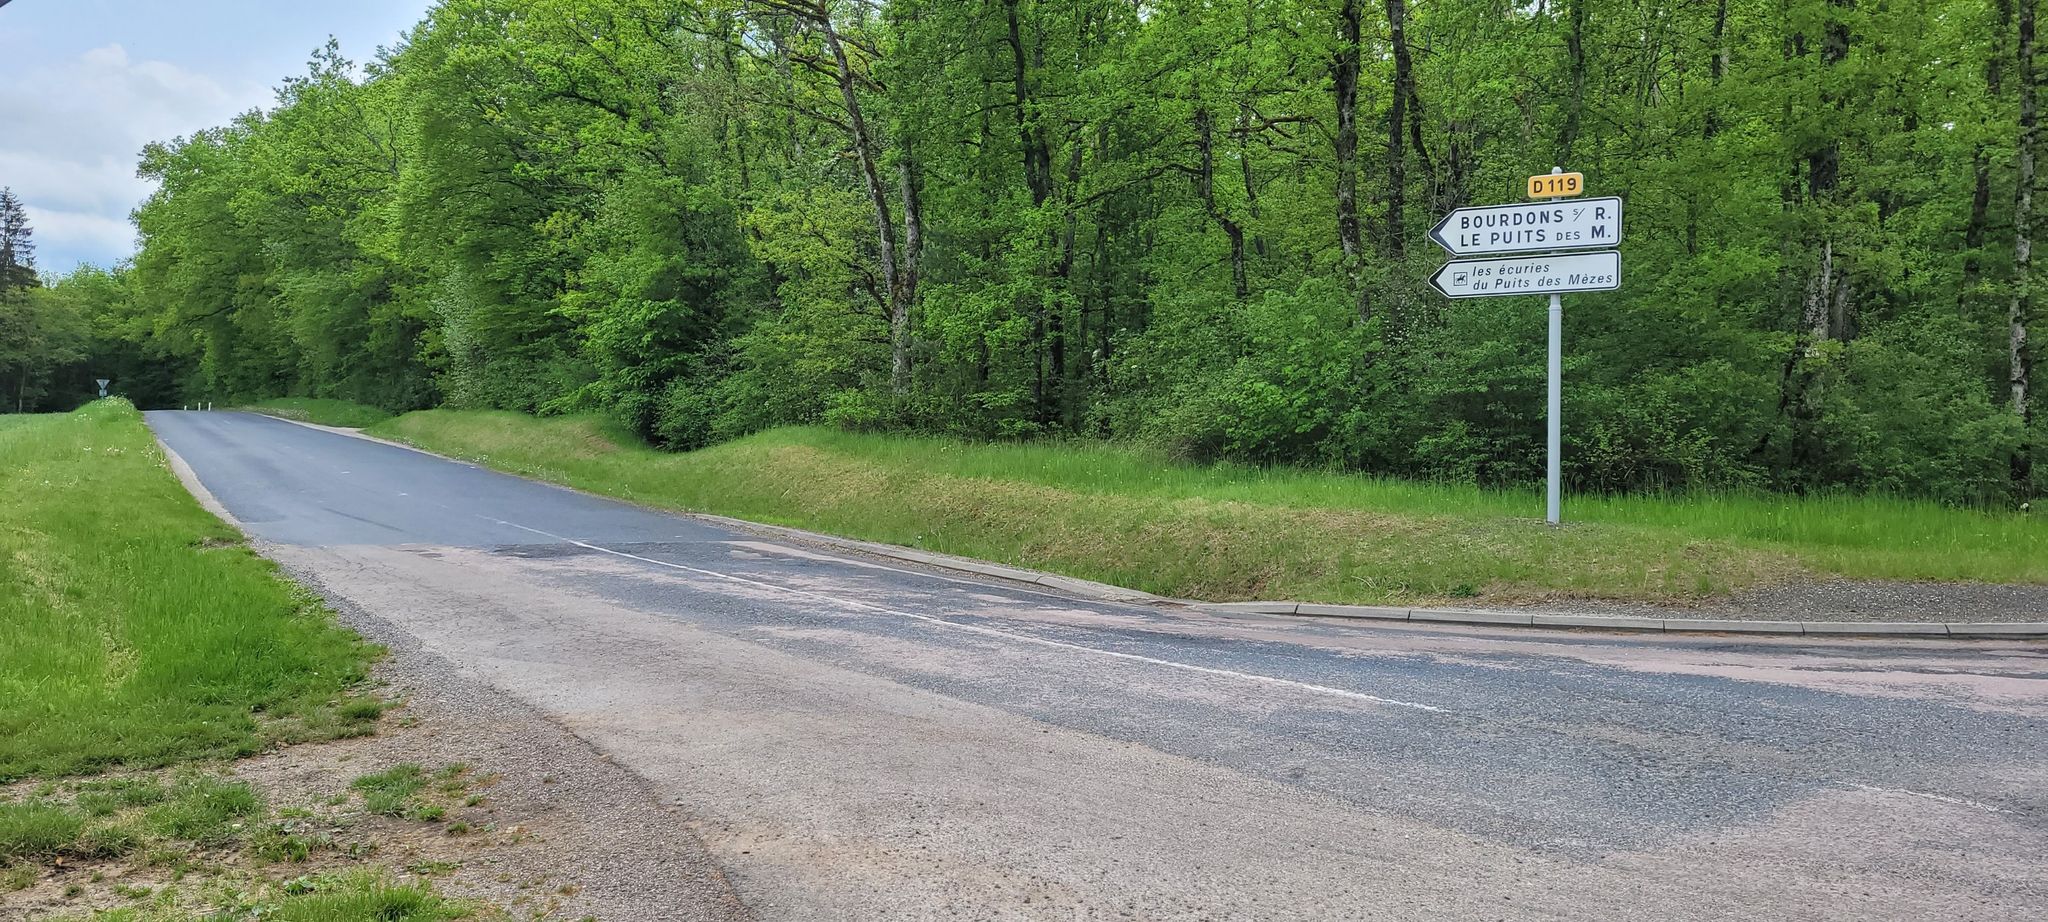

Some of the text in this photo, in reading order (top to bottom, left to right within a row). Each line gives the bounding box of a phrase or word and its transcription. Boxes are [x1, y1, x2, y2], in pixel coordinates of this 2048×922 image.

[1533, 178, 1577, 194] D 119
[1461, 209, 1563, 229] BOURDONS
[1595, 207, 1612, 220] R.
[1461, 225, 1612, 247] LE PUITS DES M.
[1472, 263, 1550, 277] les écuries
[1473, 273, 1613, 290] du Puits des Mèzes
